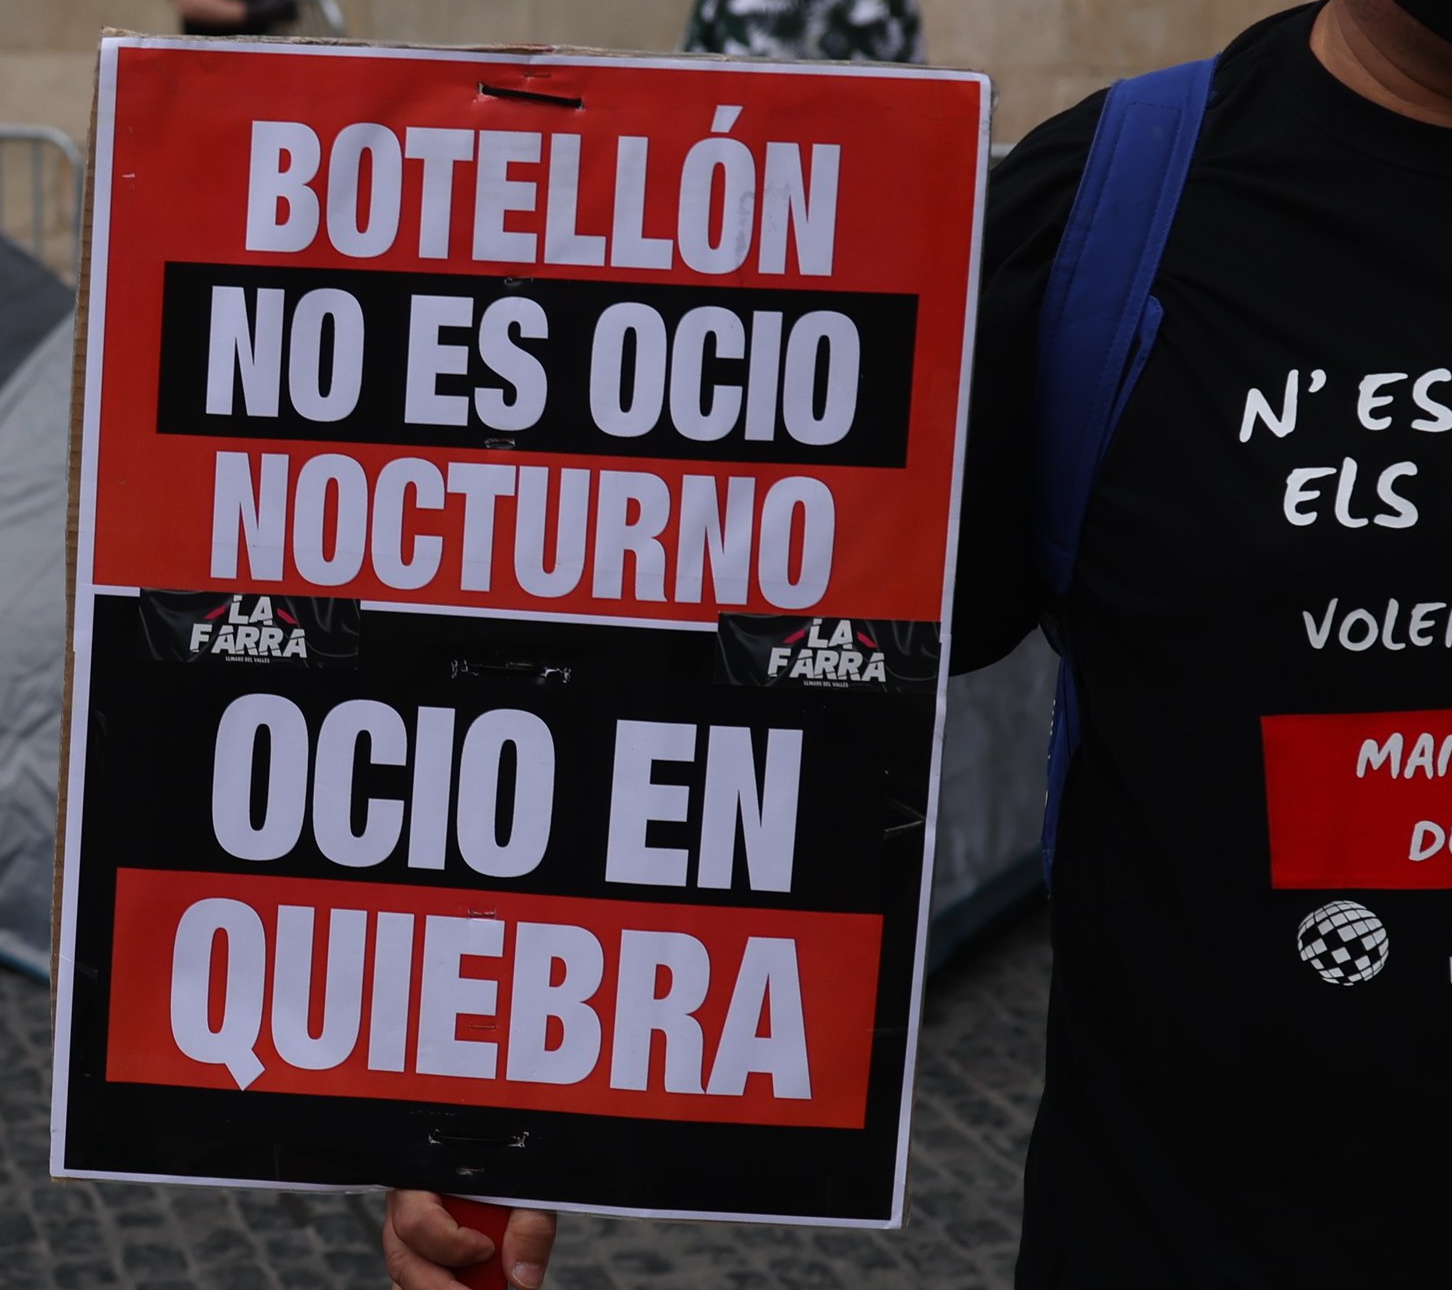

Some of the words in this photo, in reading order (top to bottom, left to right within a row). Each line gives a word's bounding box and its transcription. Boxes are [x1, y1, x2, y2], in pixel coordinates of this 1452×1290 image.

[245, 104, 841, 277] BOTELLÓN
[205, 285, 365, 422] NO
[404, 294, 549, 431] ES
[589, 301, 861, 446] OCIO
[210, 450, 836, 611] NOCTURNO
[1283, 456, 1419, 529] ELS
[189, 623, 308, 659] FARRA
[228, 594, 273, 626] LA
[767, 647, 886, 683] FARRA
[807, 618, 853, 650] LA
[211, 693, 556, 878] OCIO
[604, 719, 804, 893] EN
[170, 897, 812, 1100] QUIEBRA
